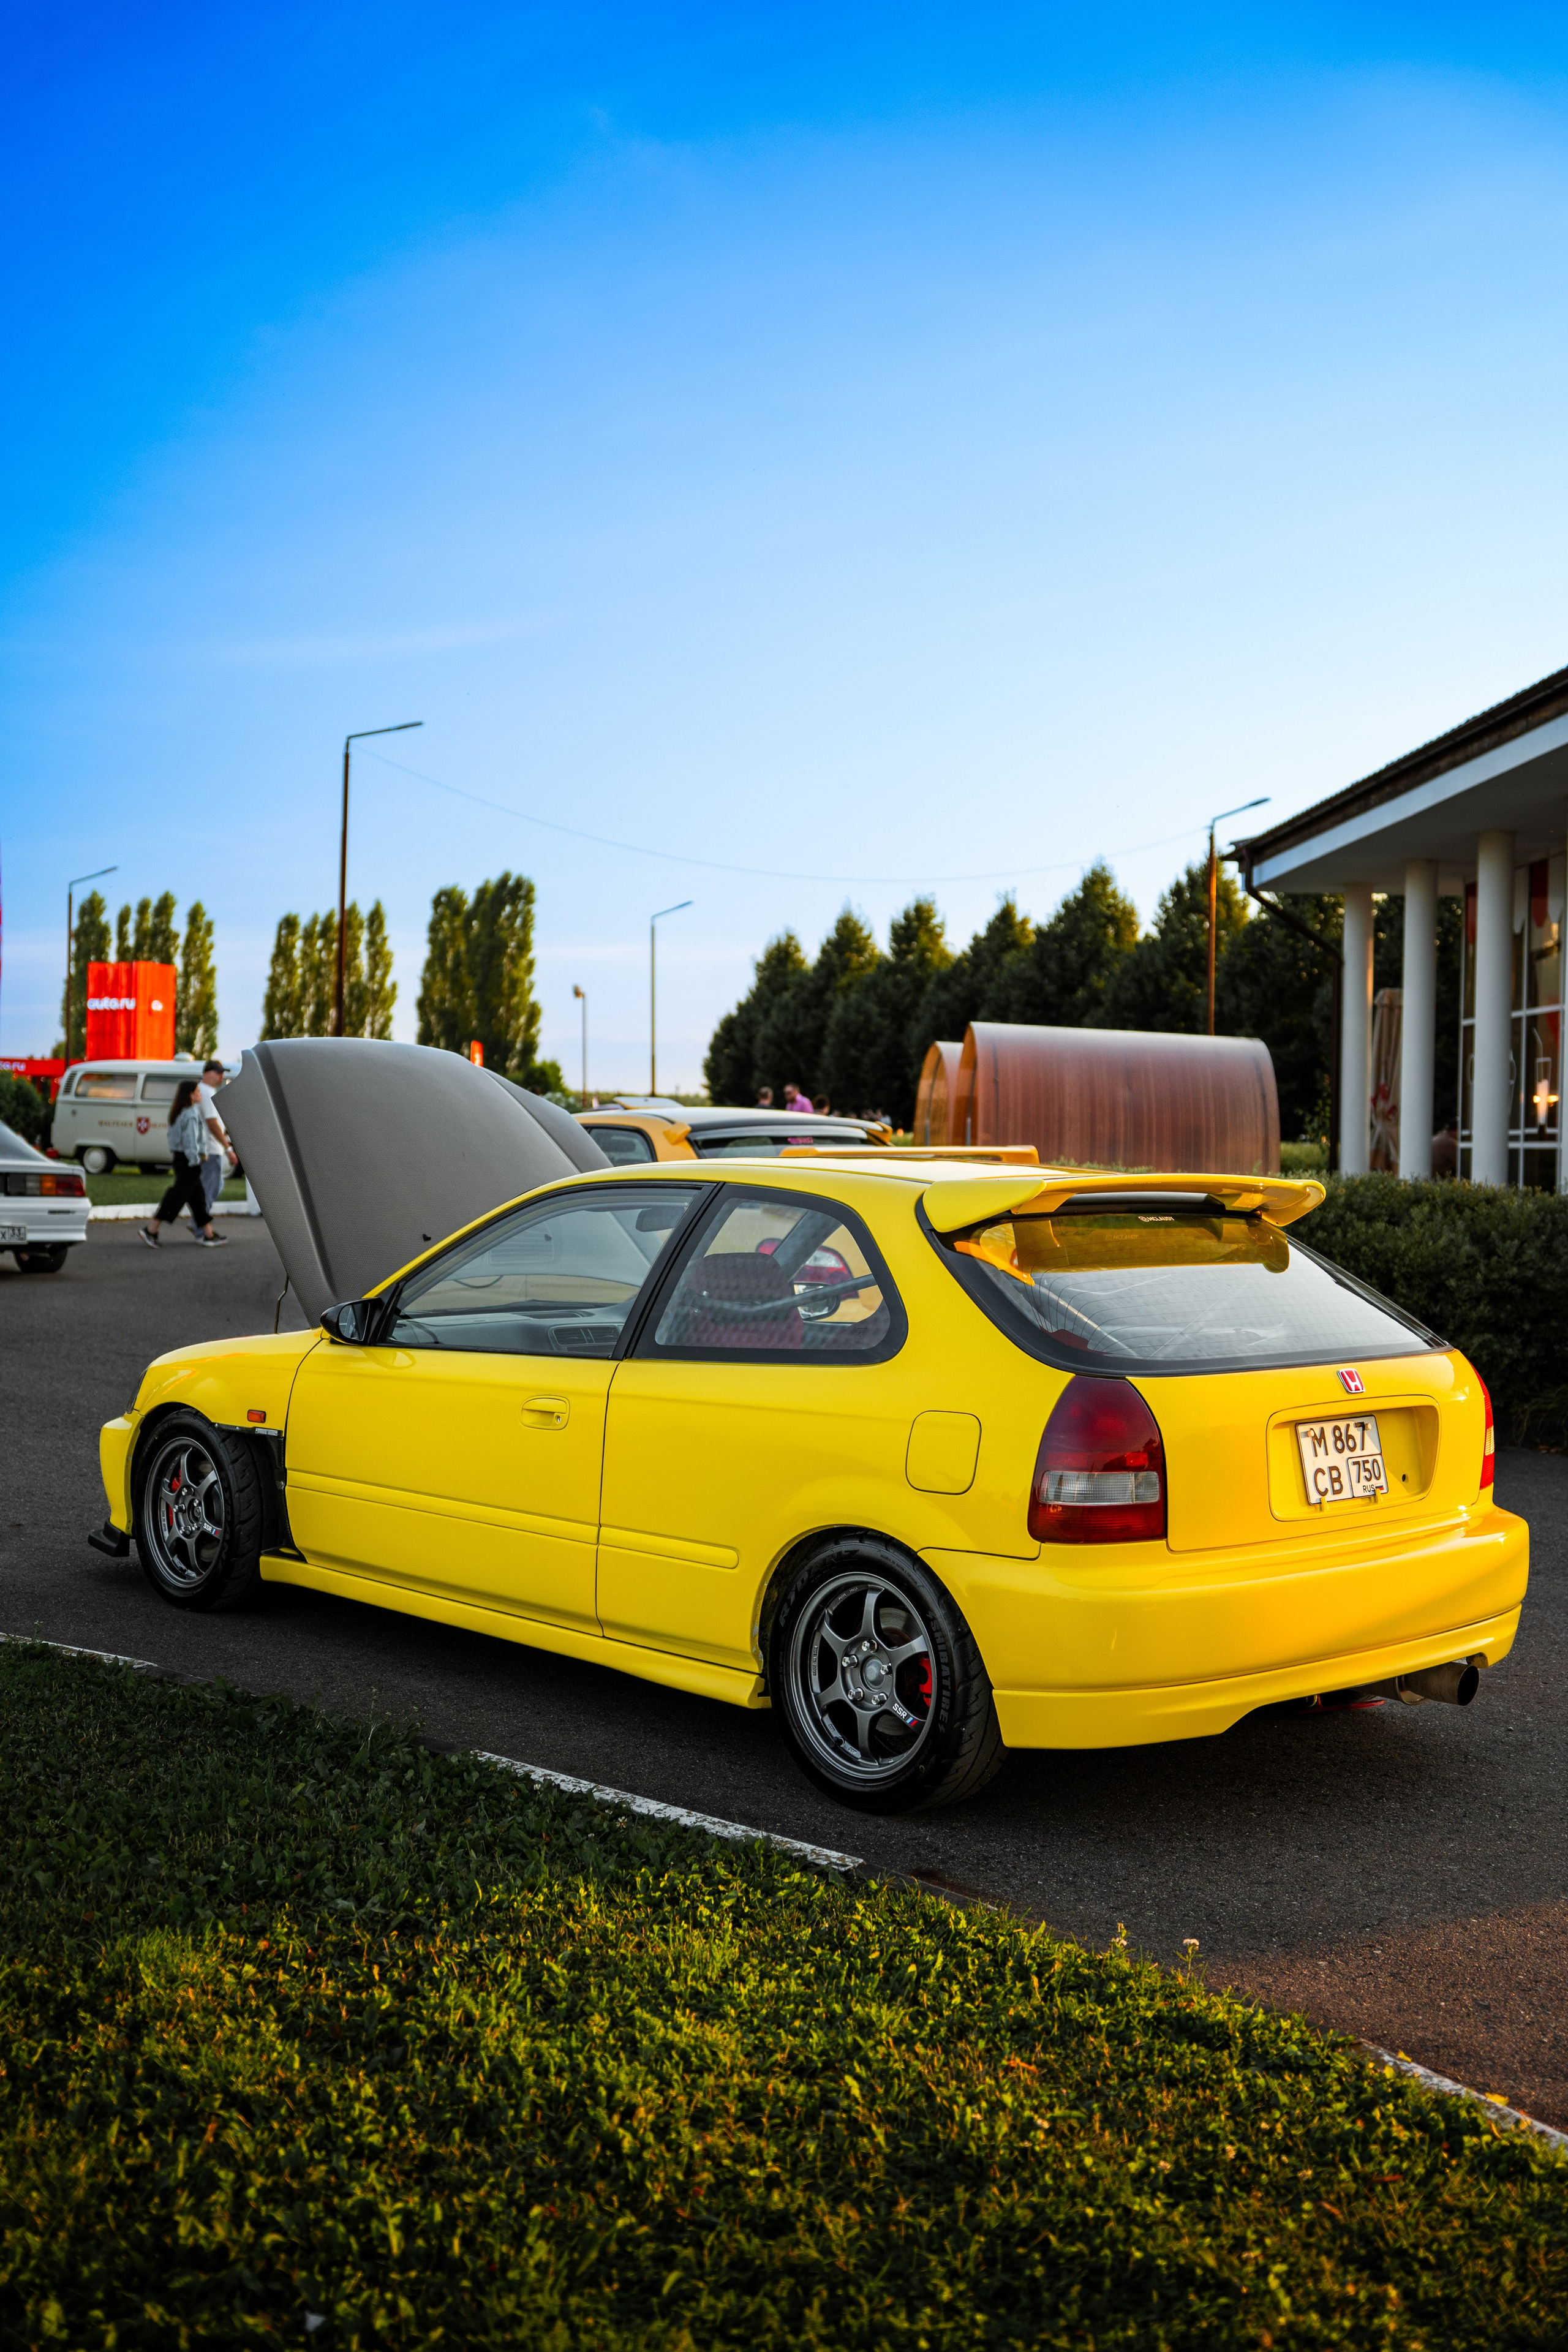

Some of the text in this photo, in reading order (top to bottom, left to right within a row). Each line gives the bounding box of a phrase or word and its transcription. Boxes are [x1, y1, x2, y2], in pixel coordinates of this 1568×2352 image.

[87, 997, 136, 1010] auto.ru
[1310, 1422, 1366, 1457] M 867
[1314, 1458, 1381, 1496] CB 750
[1363, 1484, 1376, 1493] RUS
[203, 1523, 212, 1532] SSR
[930, 1619, 951, 1724] SHIBATIRE
[892, 1703, 907, 1719] SSR
